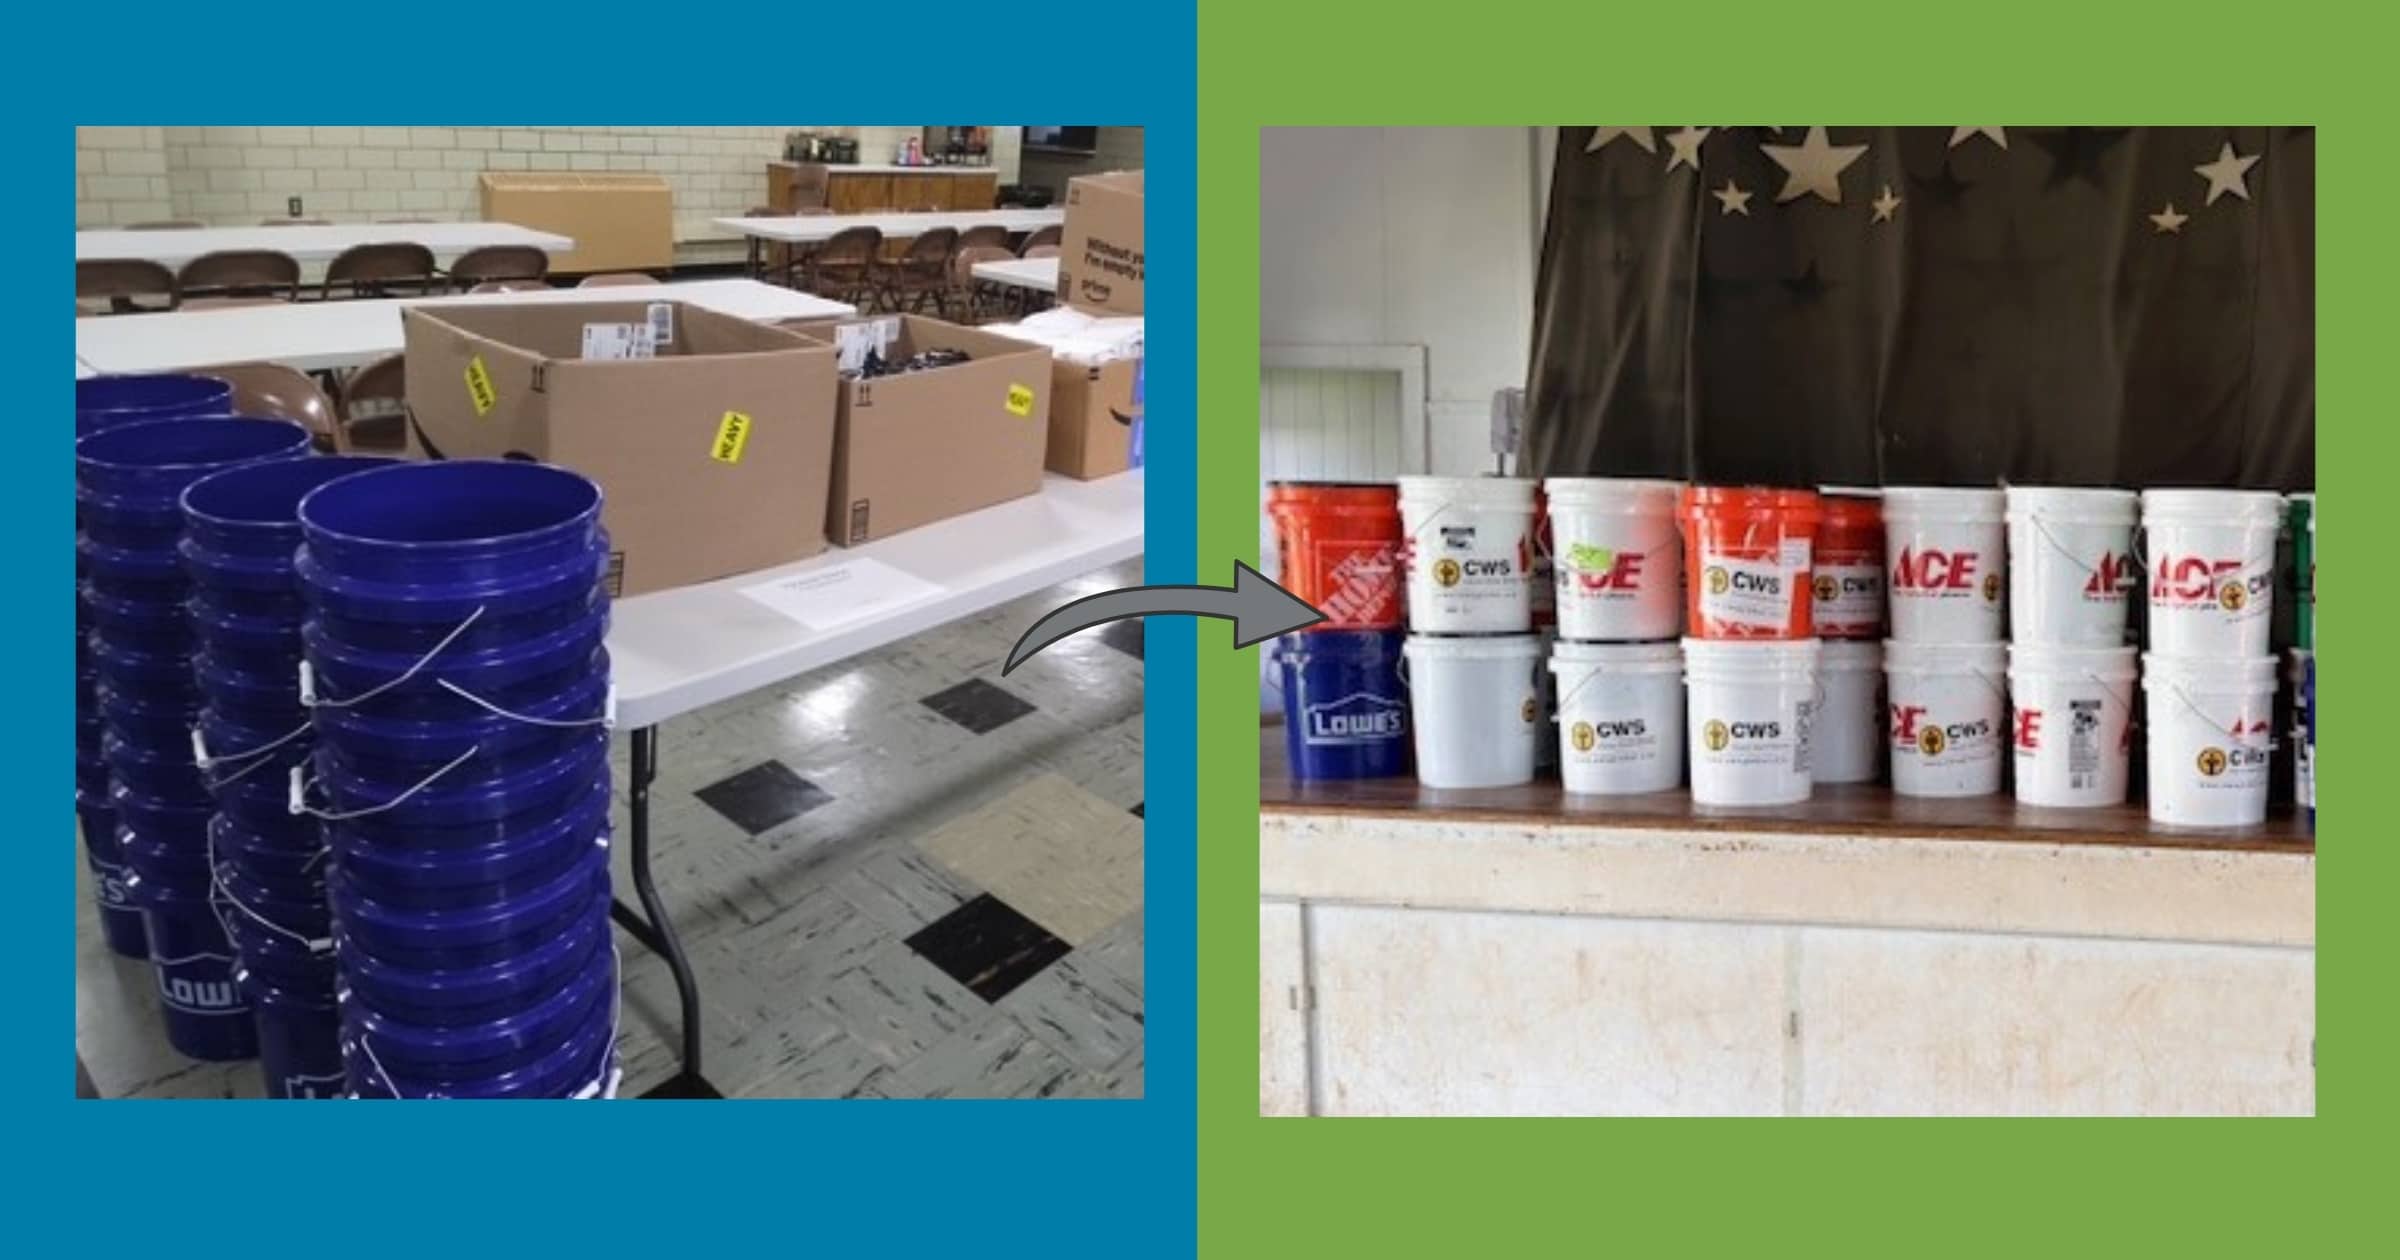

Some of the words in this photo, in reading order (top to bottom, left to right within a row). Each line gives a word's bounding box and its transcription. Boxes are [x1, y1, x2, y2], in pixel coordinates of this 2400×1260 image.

[719, 415, 743, 458] HEAVY
[1463, 559, 1511, 576] CWS
[1893, 545, 1978, 589] ACE
[1732, 570, 1780, 595] CWS
[1597, 719, 1646, 738] CWS
[1731, 721, 1780, 738] CWS
[1947, 720, 1990, 739] CWS
